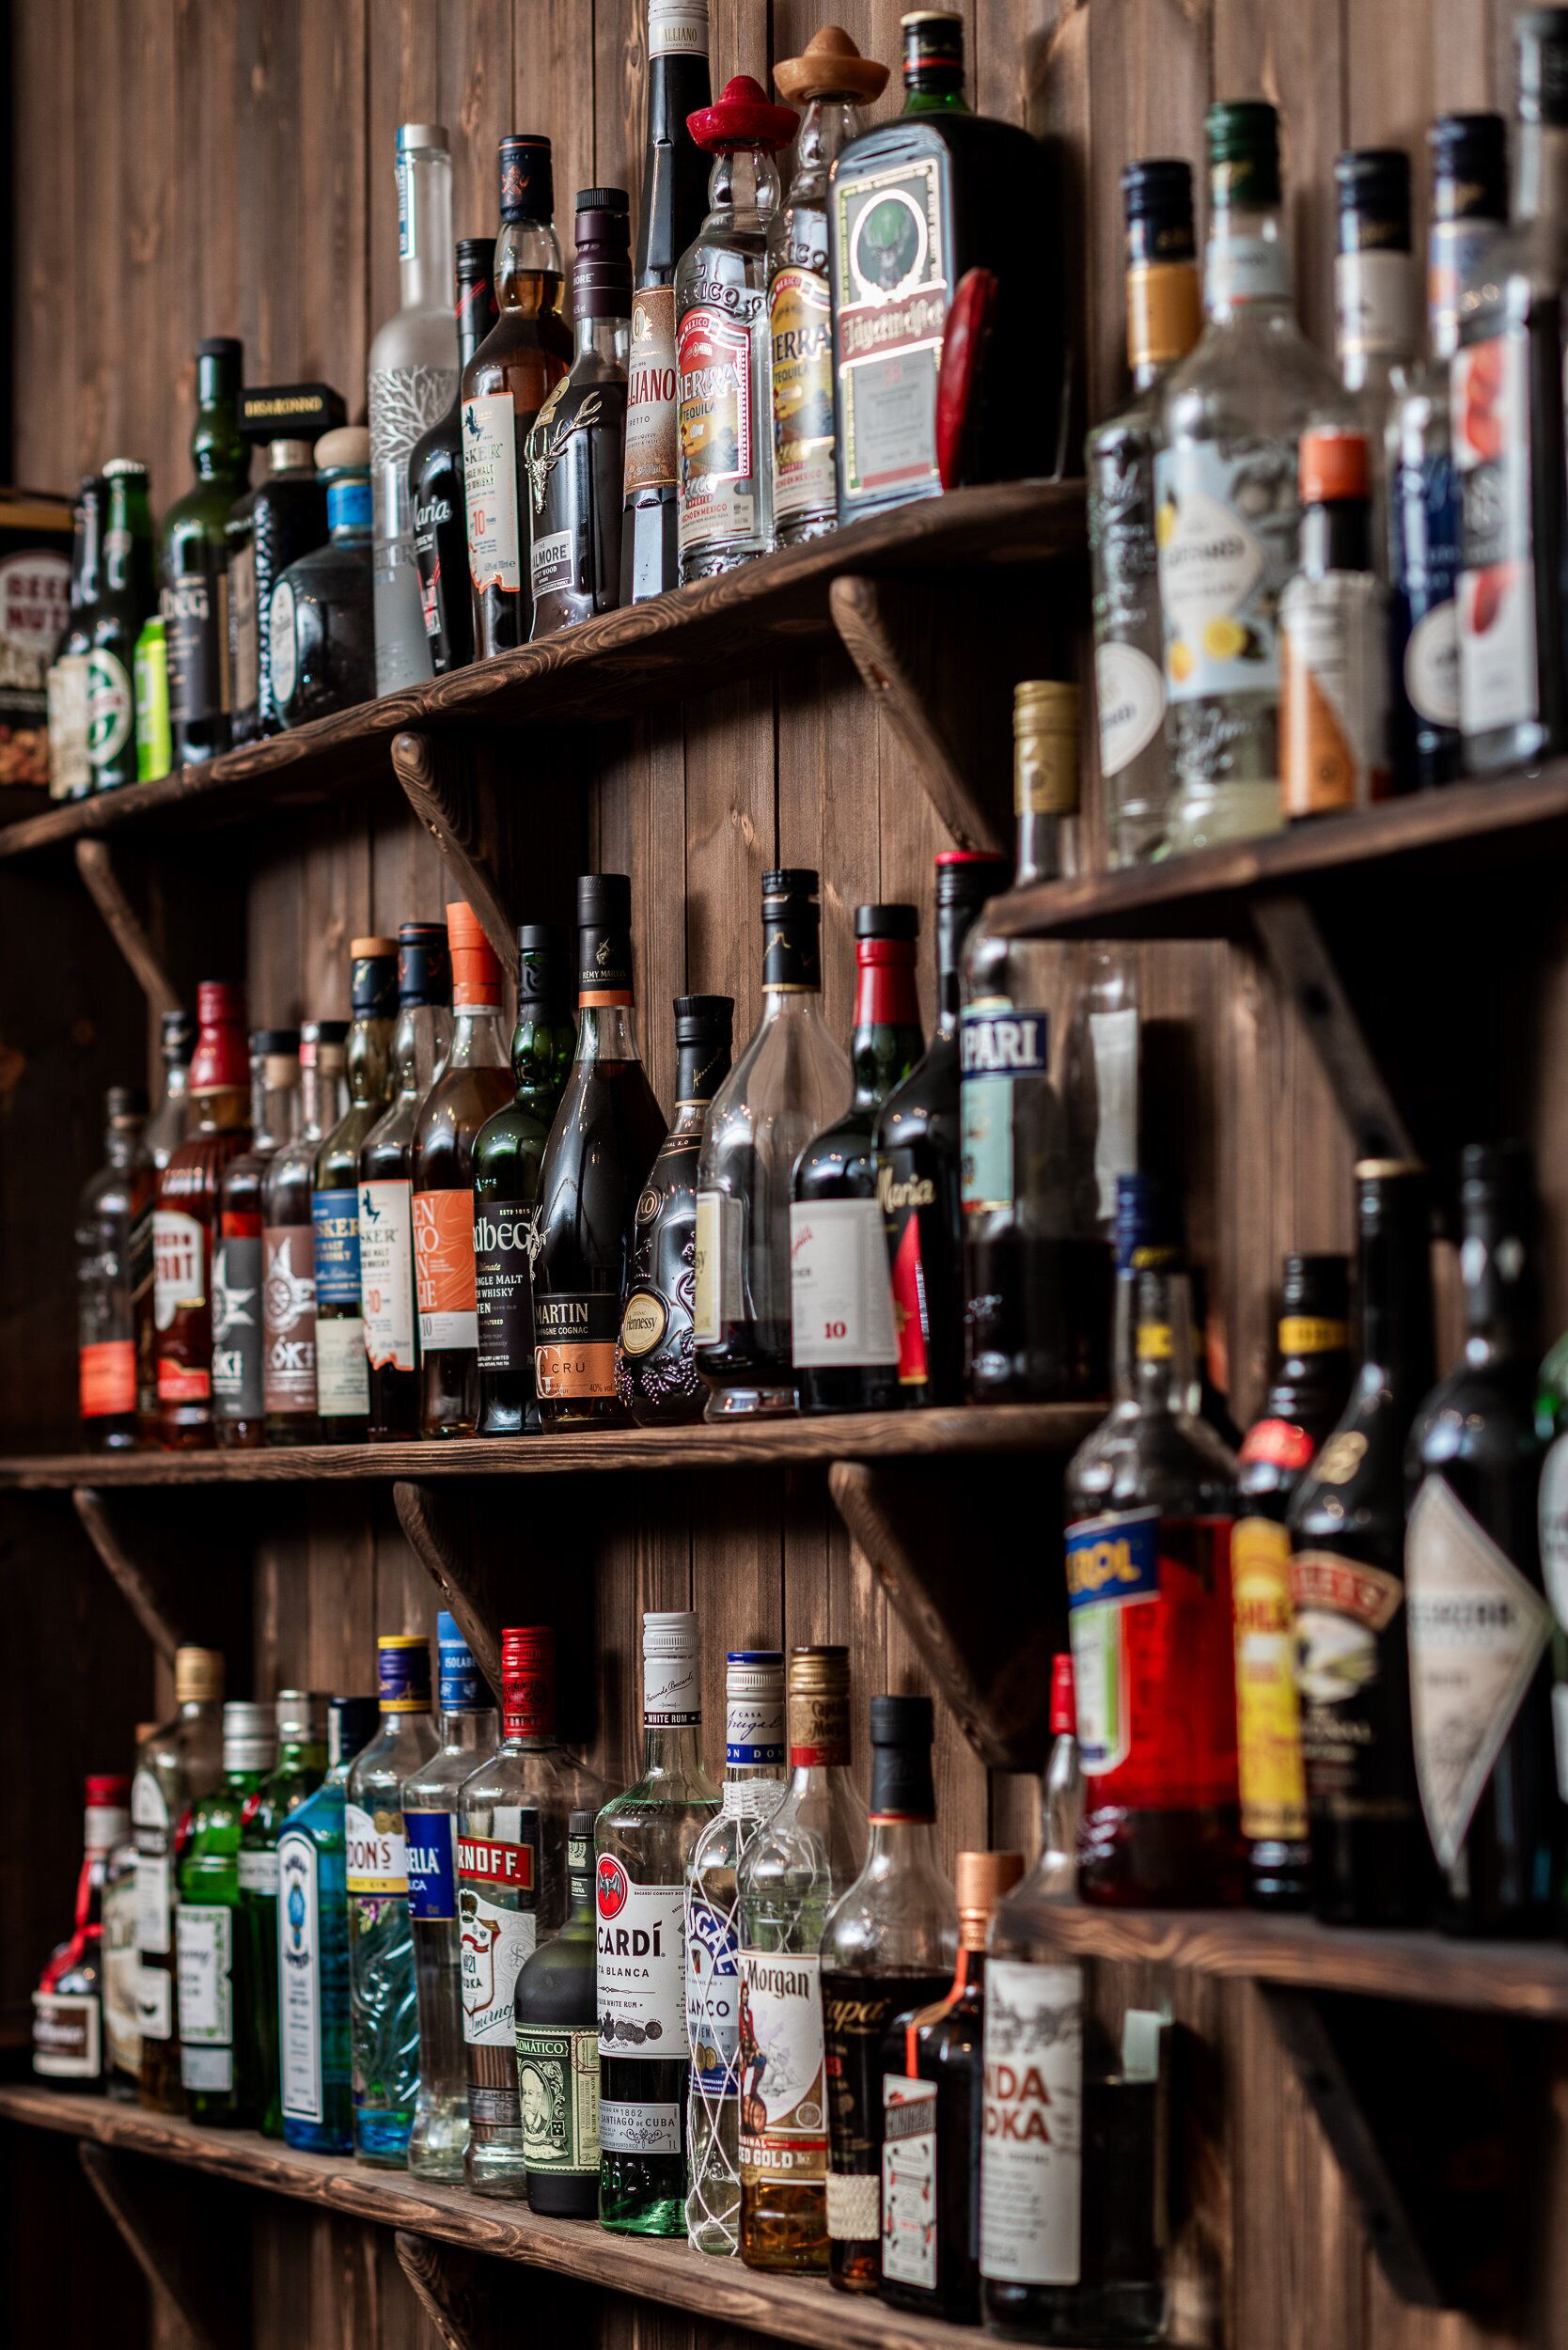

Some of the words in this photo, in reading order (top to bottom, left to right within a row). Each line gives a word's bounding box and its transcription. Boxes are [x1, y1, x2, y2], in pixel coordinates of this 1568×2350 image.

[684, 317, 710, 332] MEXICO
[682, 400, 716, 422] TEQUILA
[700, 503, 727, 516] MEXICO
[473, 509, 485, 538] 10
[601, 969, 626, 978] MARTIN
[495, 1275, 524, 1284] MALT
[481, 1287, 514, 1298] WHISKY
[535, 1303, 589, 1324] MARTIN
[422, 1317, 432, 1338] 10
[558, 1325, 589, 1335] COGNAC
[626, 1315, 658, 1332] Hennessy
[824, 1321, 848, 1340] 10
[551, 1362, 586, 1374] CRU
[588, 1383, 603, 1392] 40%
[649, 1714, 669, 1723] WHITE
[671, 1714, 687, 1723] RUM
[606, 1966, 650, 1978] BLANCA
[747, 1960, 809, 2001] Morgan
[607, 1999, 622, 2008] WHITE
[623, 2000, 637, 2009] RUM
[620, 2108, 643, 2117] 1862
[601, 2114, 635, 2126] SANTIAGO
[645, 2118, 675, 2127] CUBA
[753, 2147, 793, 2170] GOLD
